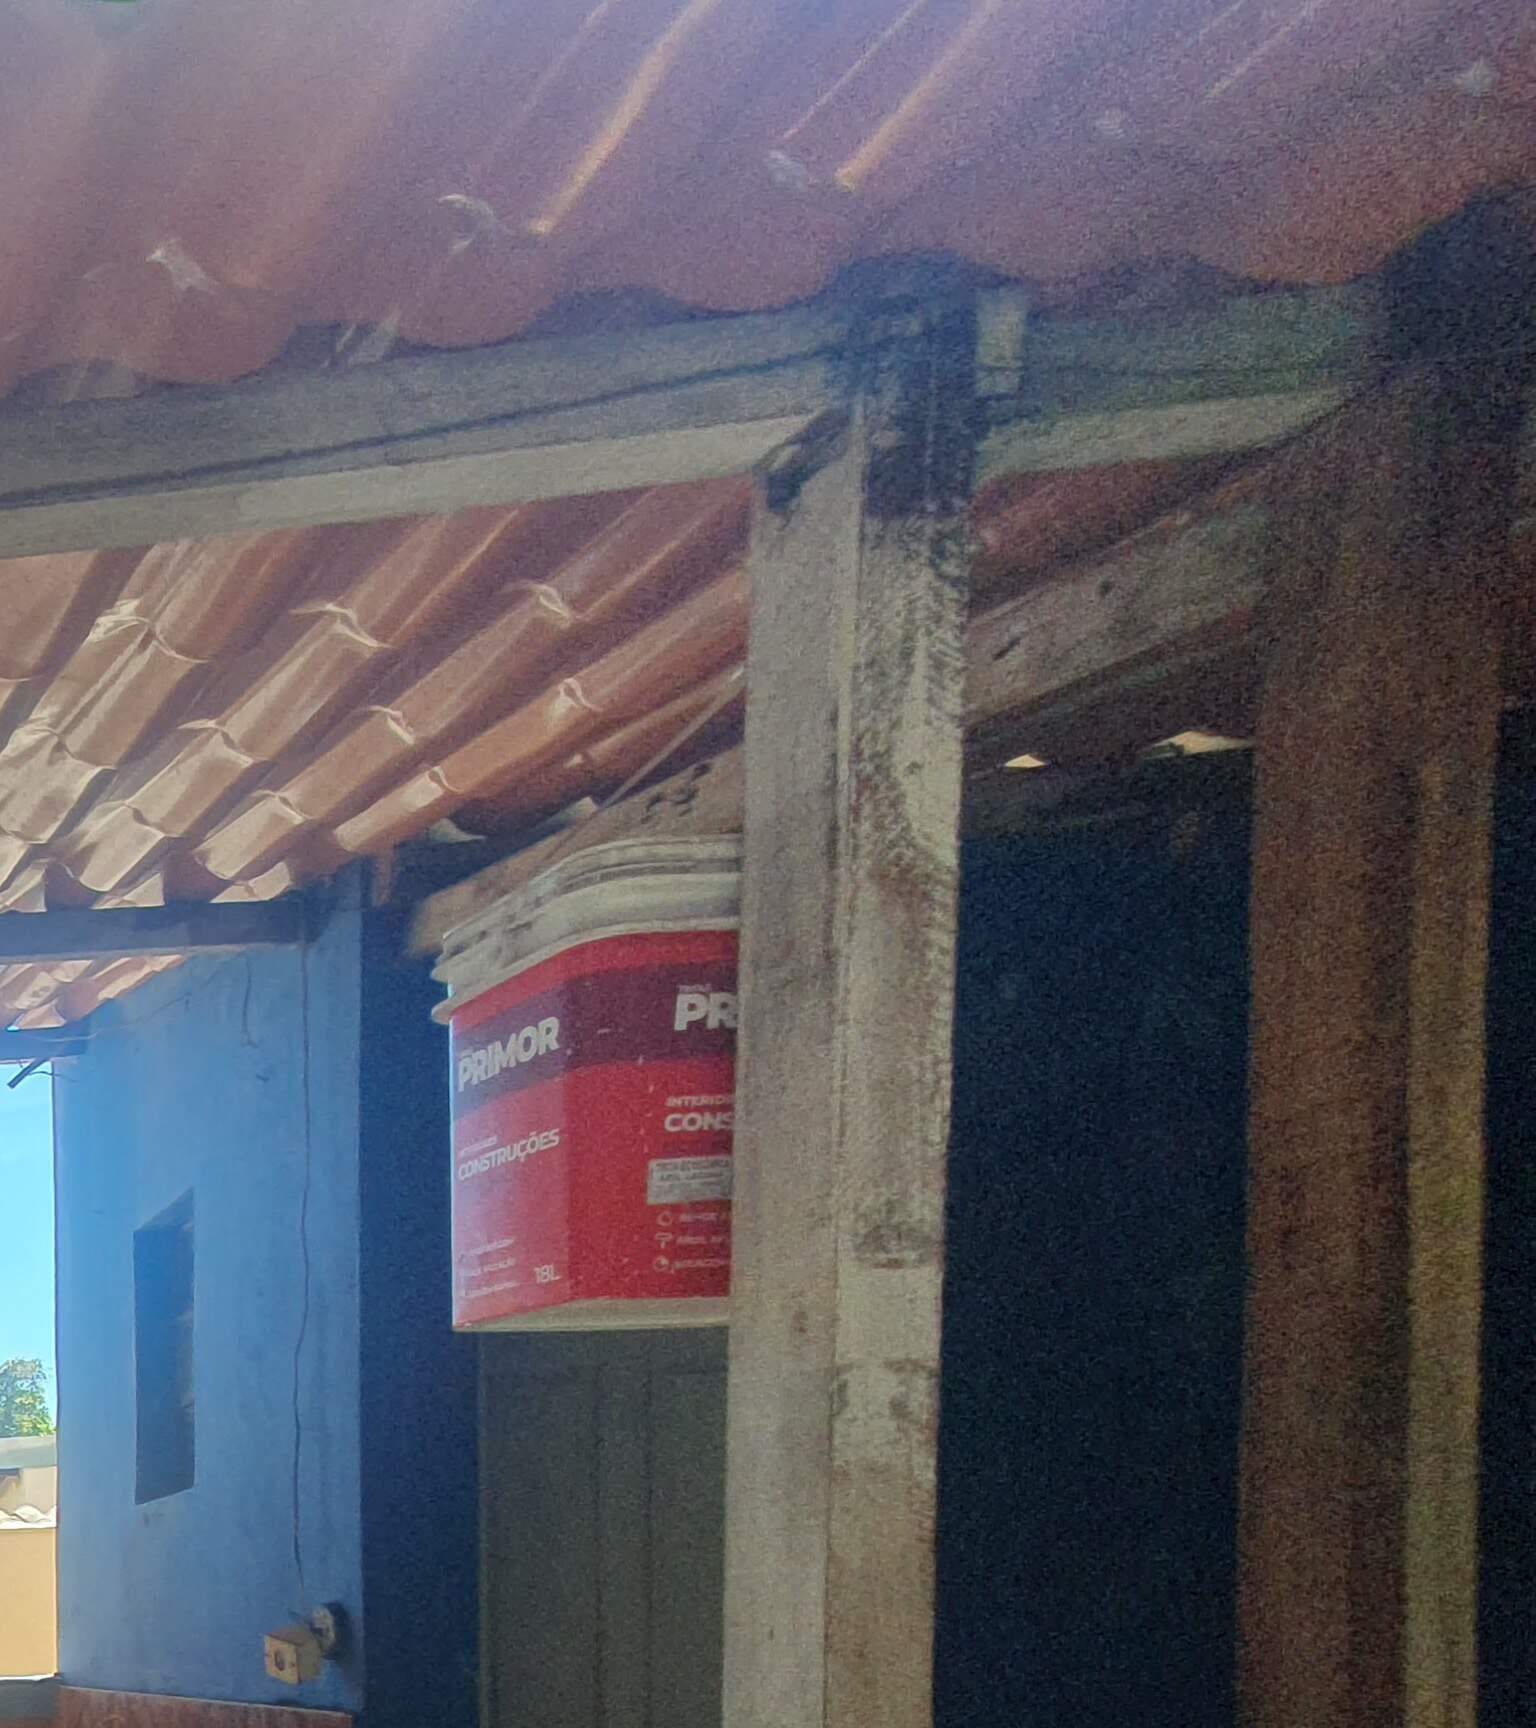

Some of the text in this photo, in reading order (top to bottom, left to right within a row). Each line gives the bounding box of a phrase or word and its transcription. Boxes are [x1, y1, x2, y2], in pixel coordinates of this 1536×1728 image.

[458, 1016, 560, 1092] PRIMOR
[458, 1128, 561, 1180] CONSTRUÇÕES
[534, 1264, 562, 1284] 18L
